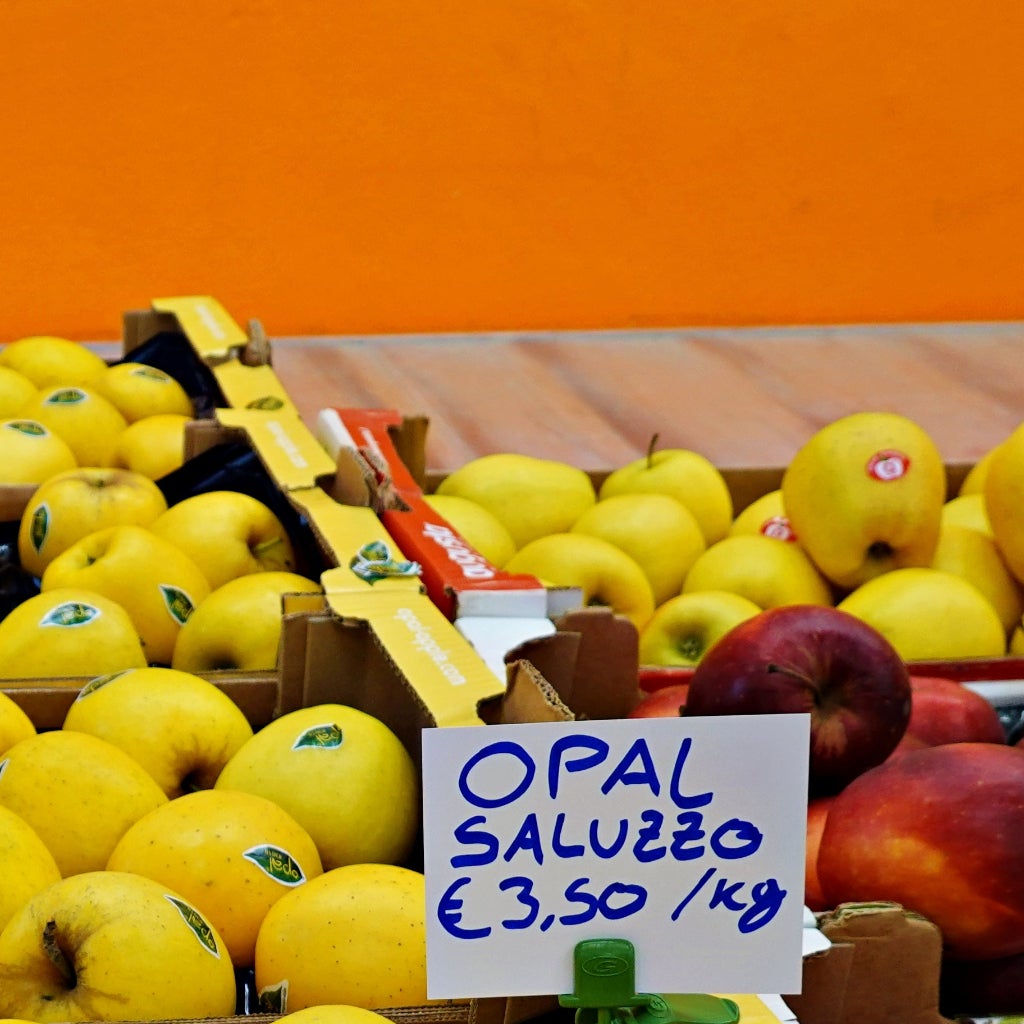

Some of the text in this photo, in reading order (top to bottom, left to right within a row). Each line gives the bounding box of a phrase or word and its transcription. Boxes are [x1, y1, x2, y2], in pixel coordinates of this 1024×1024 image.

[458, 734, 714, 809] OPAL
[450, 809, 764, 868] SALUZZO
[269, 856, 299, 879] opal
[188, 913, 215, 949] opal
